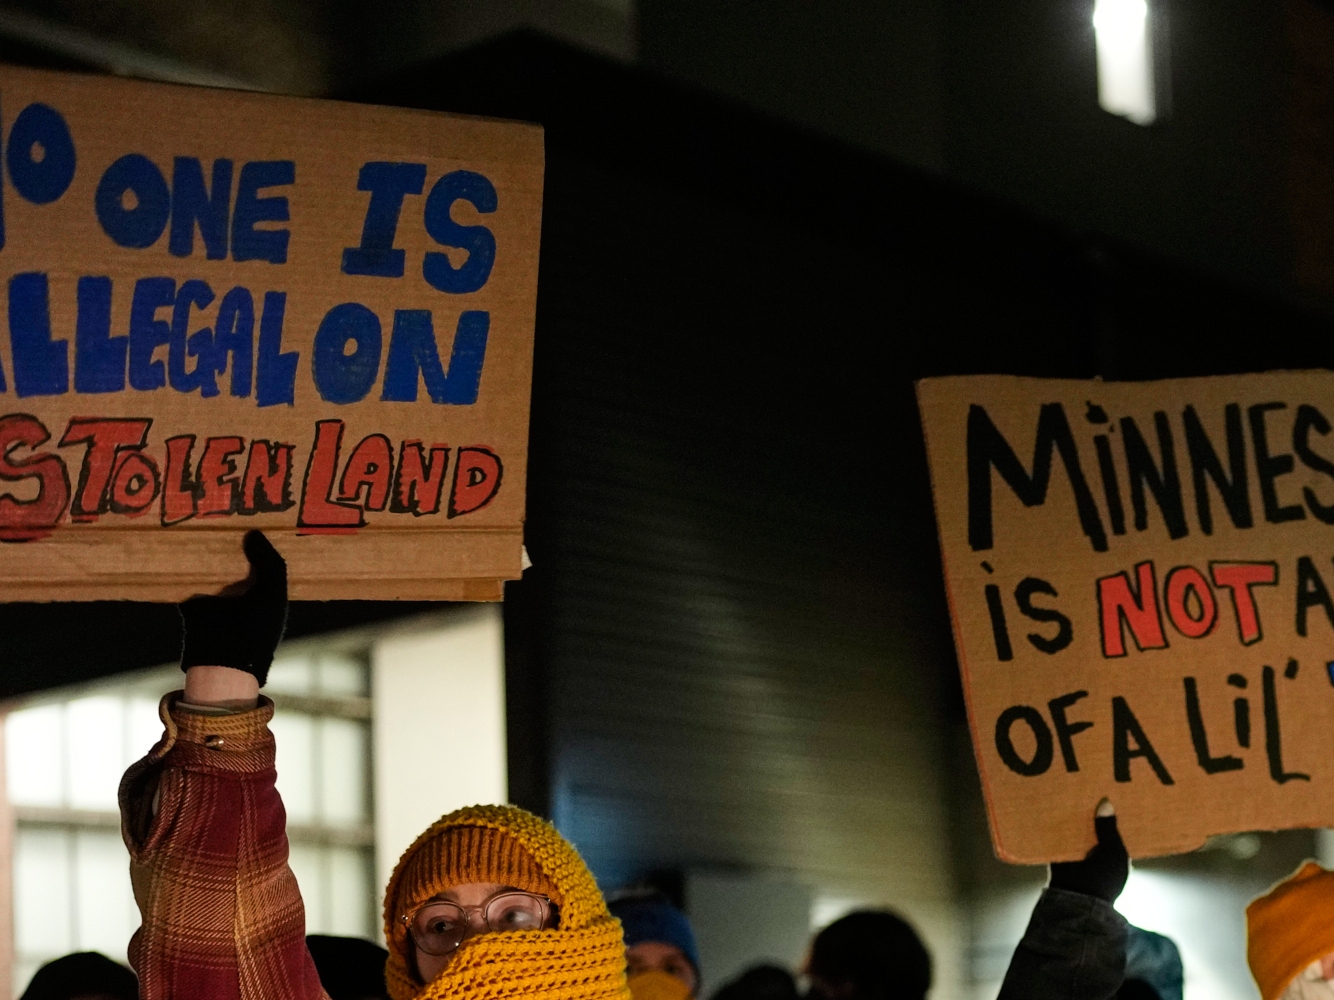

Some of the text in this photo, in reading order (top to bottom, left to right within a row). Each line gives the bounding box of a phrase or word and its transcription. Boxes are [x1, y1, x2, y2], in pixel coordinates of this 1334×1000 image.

[95, 153, 296, 265] ONE
[340, 160, 499, 295] IS
[0, 272, 491, 407] LLEGAL ON
[0, 412, 504, 542] STOLEN LAND
[1097, 560, 1278, 658] NOT
[994, 690, 1095, 777] OF
[1111, 695, 1174, 785] A
